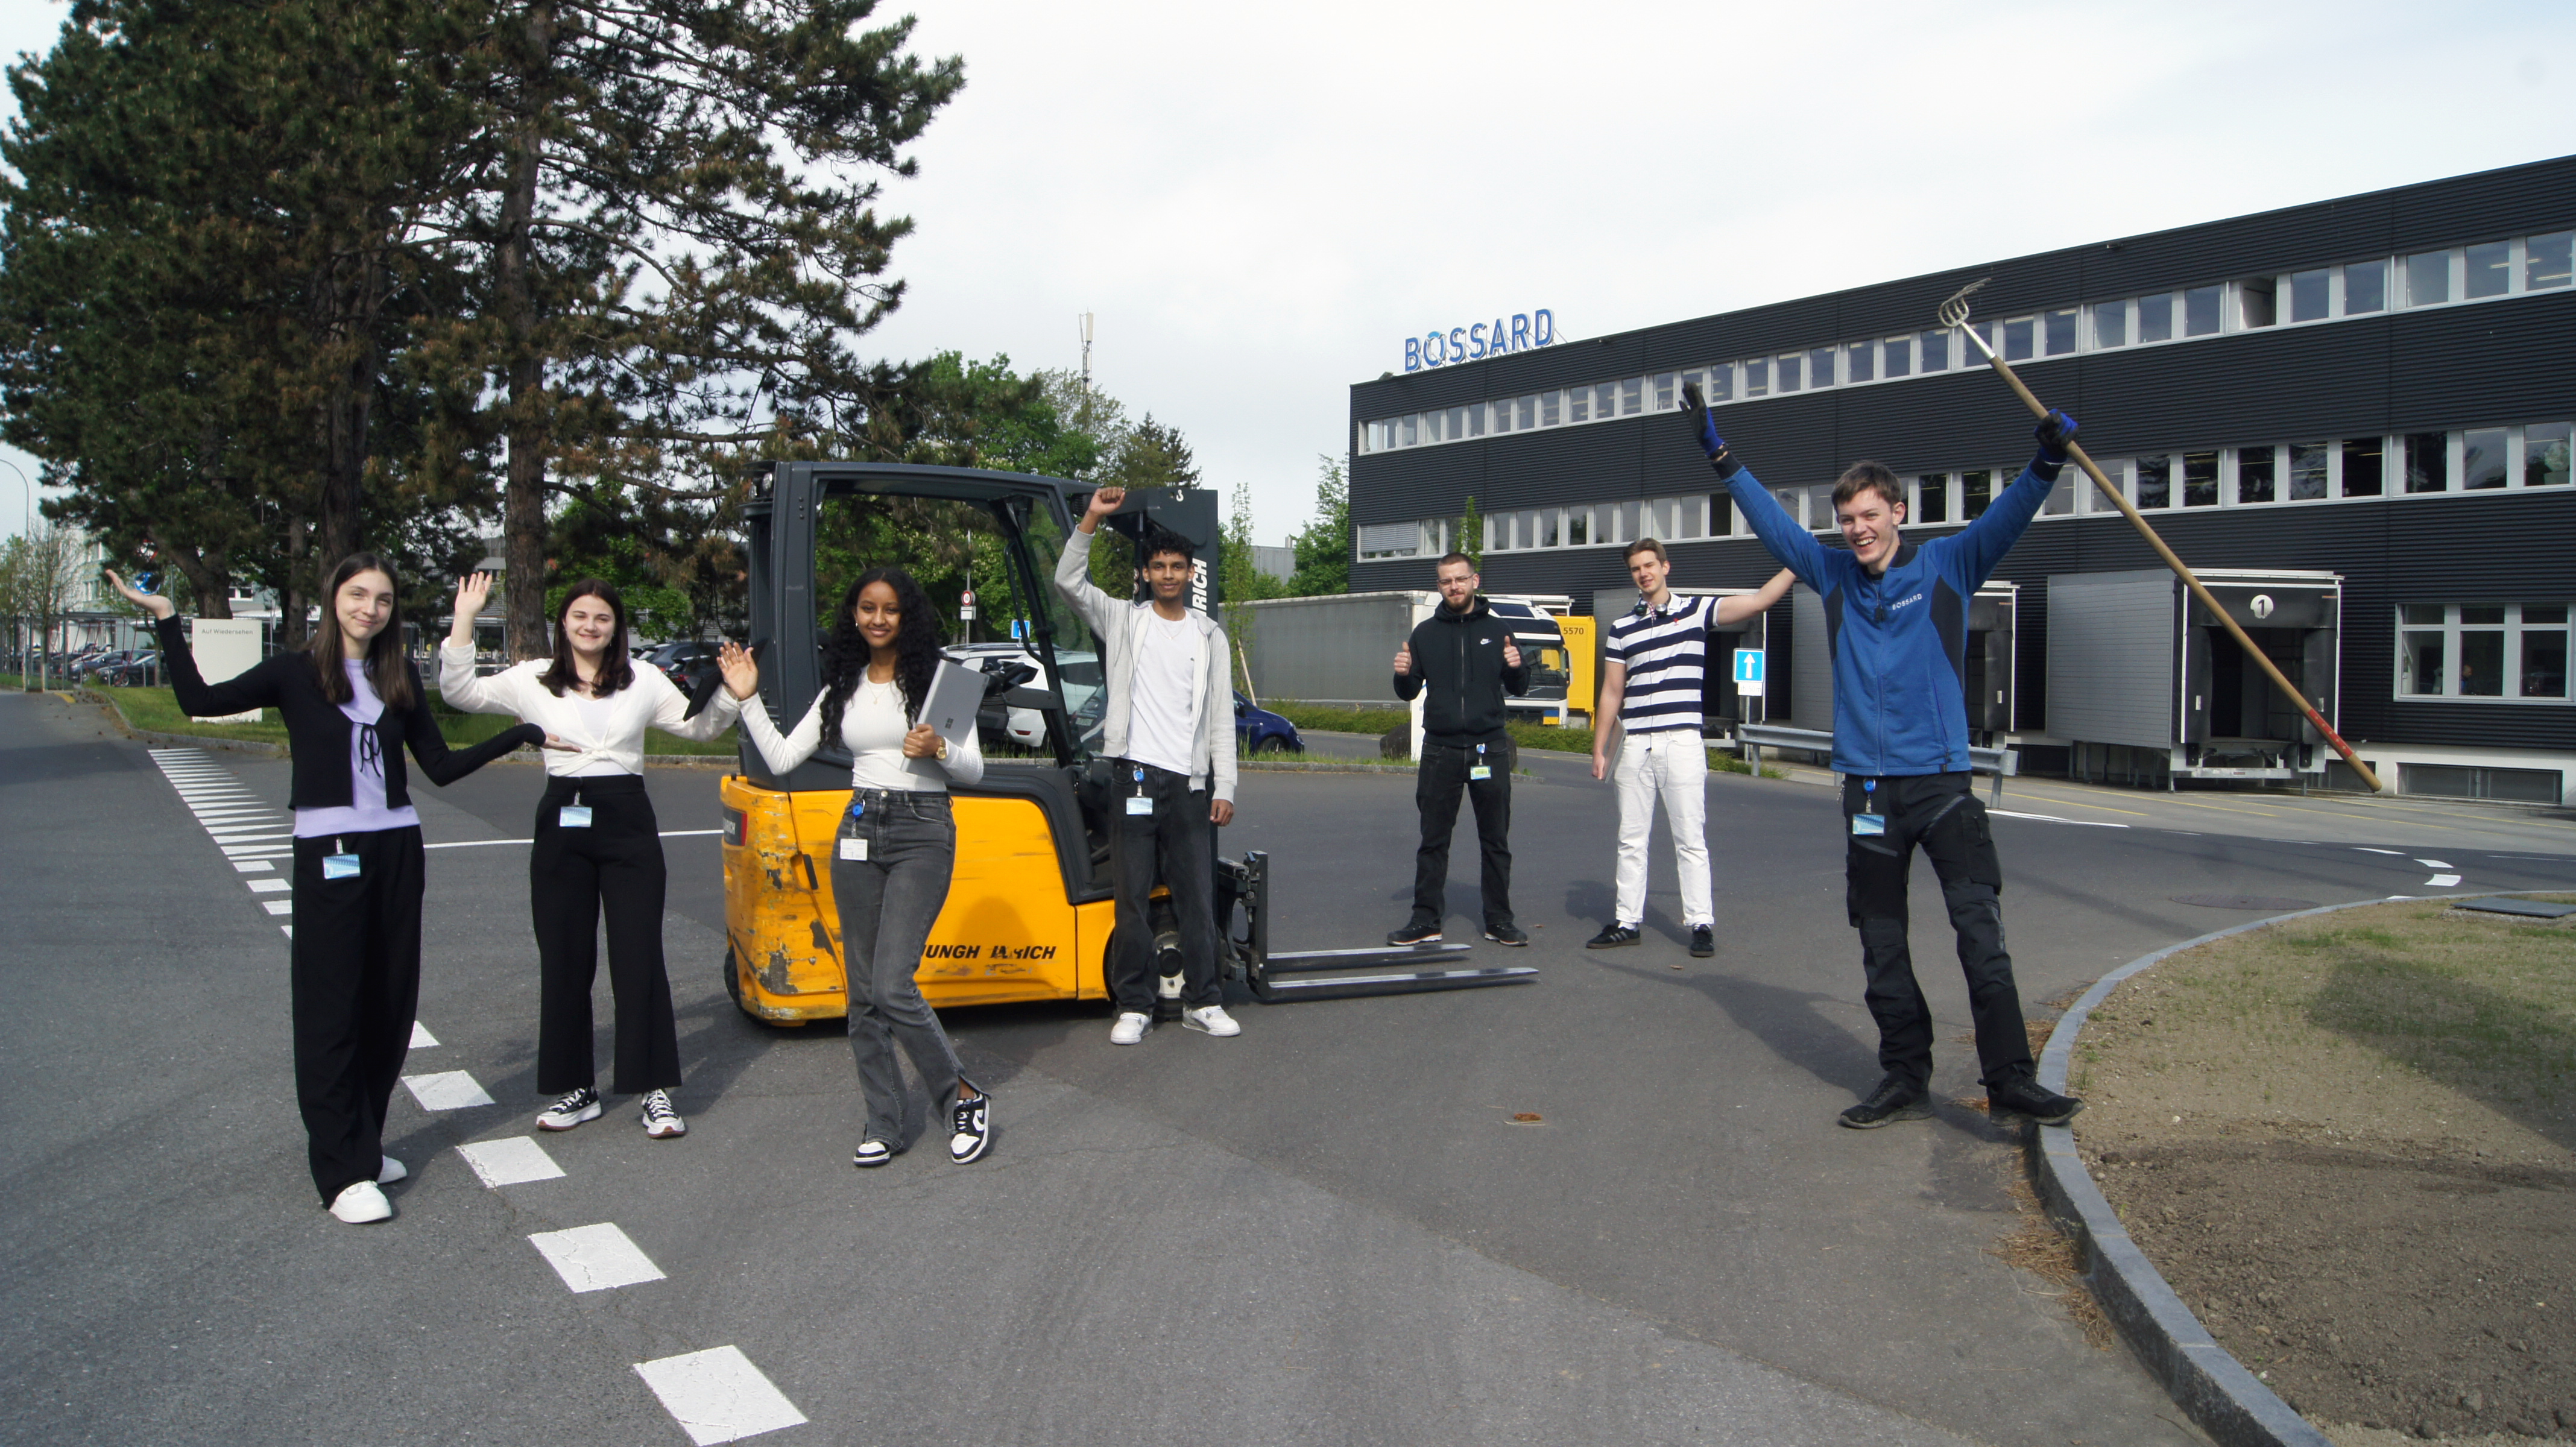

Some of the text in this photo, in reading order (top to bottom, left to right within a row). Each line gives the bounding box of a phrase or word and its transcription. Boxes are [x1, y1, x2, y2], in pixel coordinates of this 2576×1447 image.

[1405, 308, 1555, 372] BOSSARD
[1192, 558, 1207, 617] RICH
[1892, 593, 1922, 610] BOSSARD
[2258, 599, 2264, 616] 1
